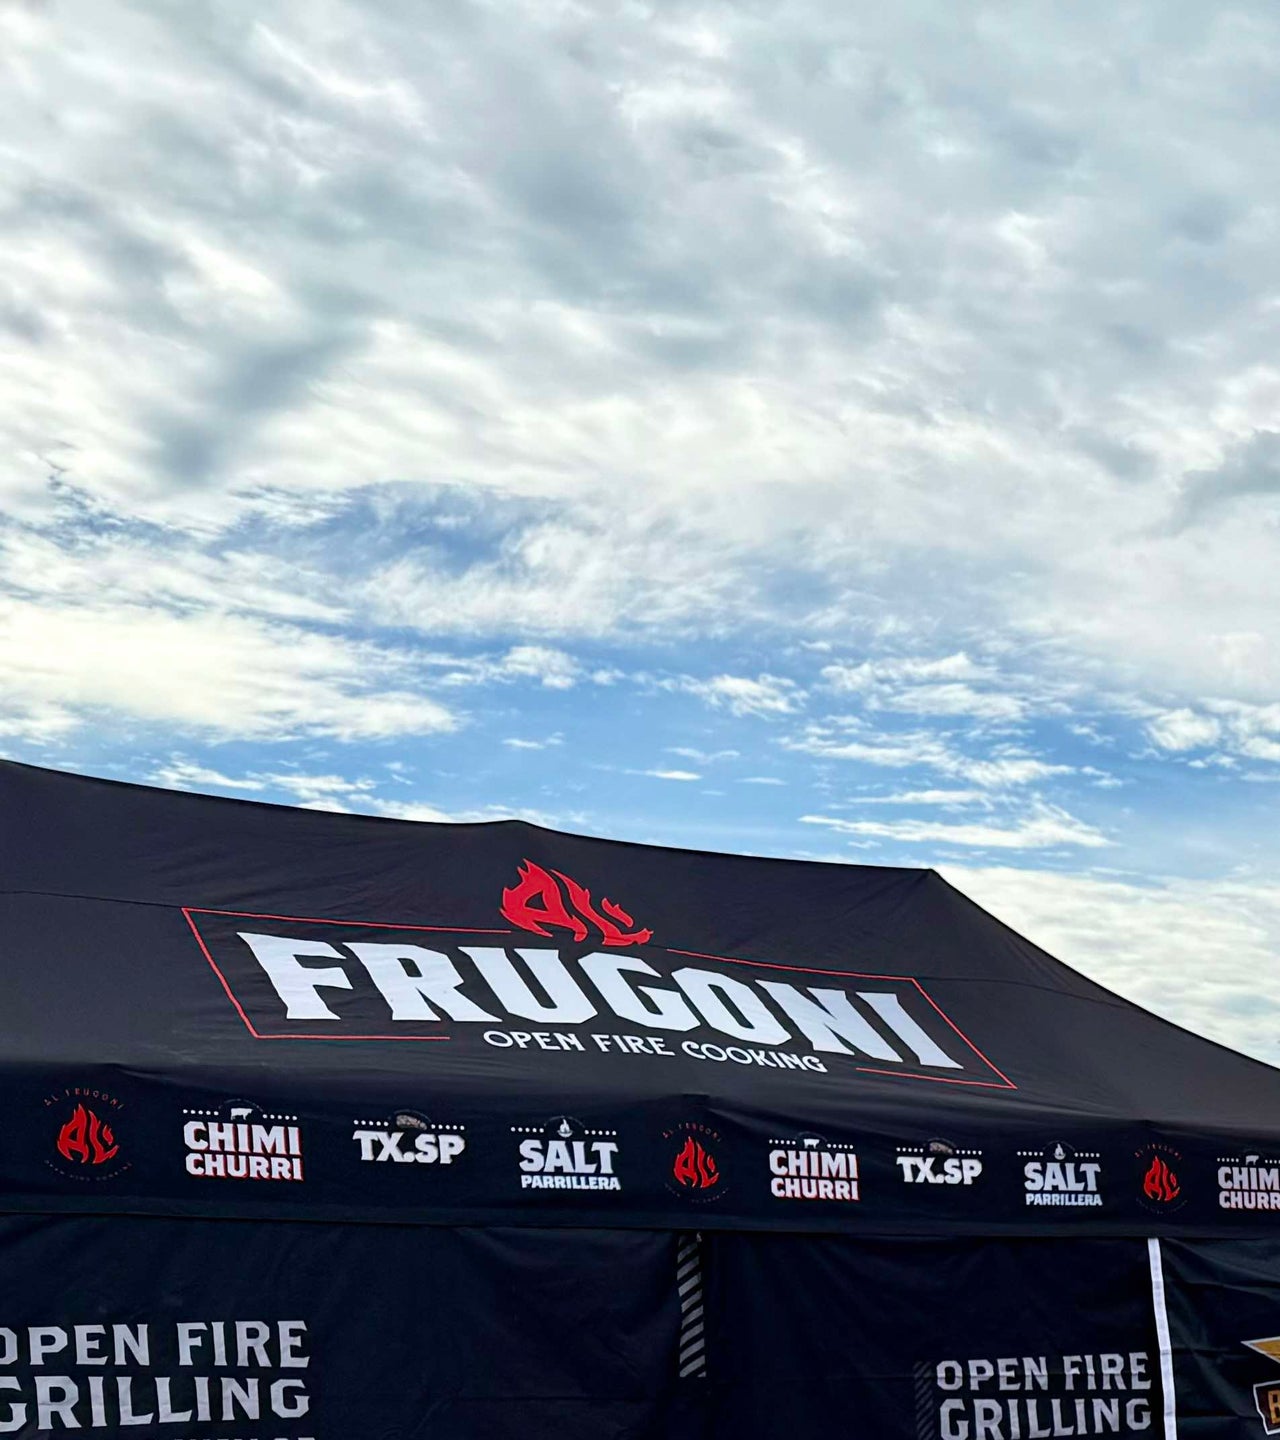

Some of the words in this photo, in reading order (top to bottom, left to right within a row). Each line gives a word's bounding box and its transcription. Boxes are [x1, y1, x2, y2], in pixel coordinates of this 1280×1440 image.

[236, 931, 965, 1070] FRUGONI
[483, 1029, 585, 1053] OPEN
[592, 1033, 676, 1059] FIRE
[681, 1039, 828, 1074] COOKING
[183, 1120, 303, 1156] CHIMI
[352, 1130, 467, 1165] TX.SP
[185, 1154, 304, 1182] CHURRI
[519, 1139, 619, 1175] SALT
[769, 1150, 859, 1179] CHIMI
[896, 1156, 983, 1185] TX.SP
[520, 1175, 622, 1191] PARRILLERA
[771, 1178, 860, 1202] CHURRI
[1023, 1161, 1101, 1192] SALT
[1025, 1192, 1103, 1206] PARRILLERA
[176, 1320, 311, 1368] FIRE
[936, 1356, 1050, 1392] OPEN
[1062, 1352, 1152, 1391] FIRE
[0, 1375, 311, 1433] GRILLING
